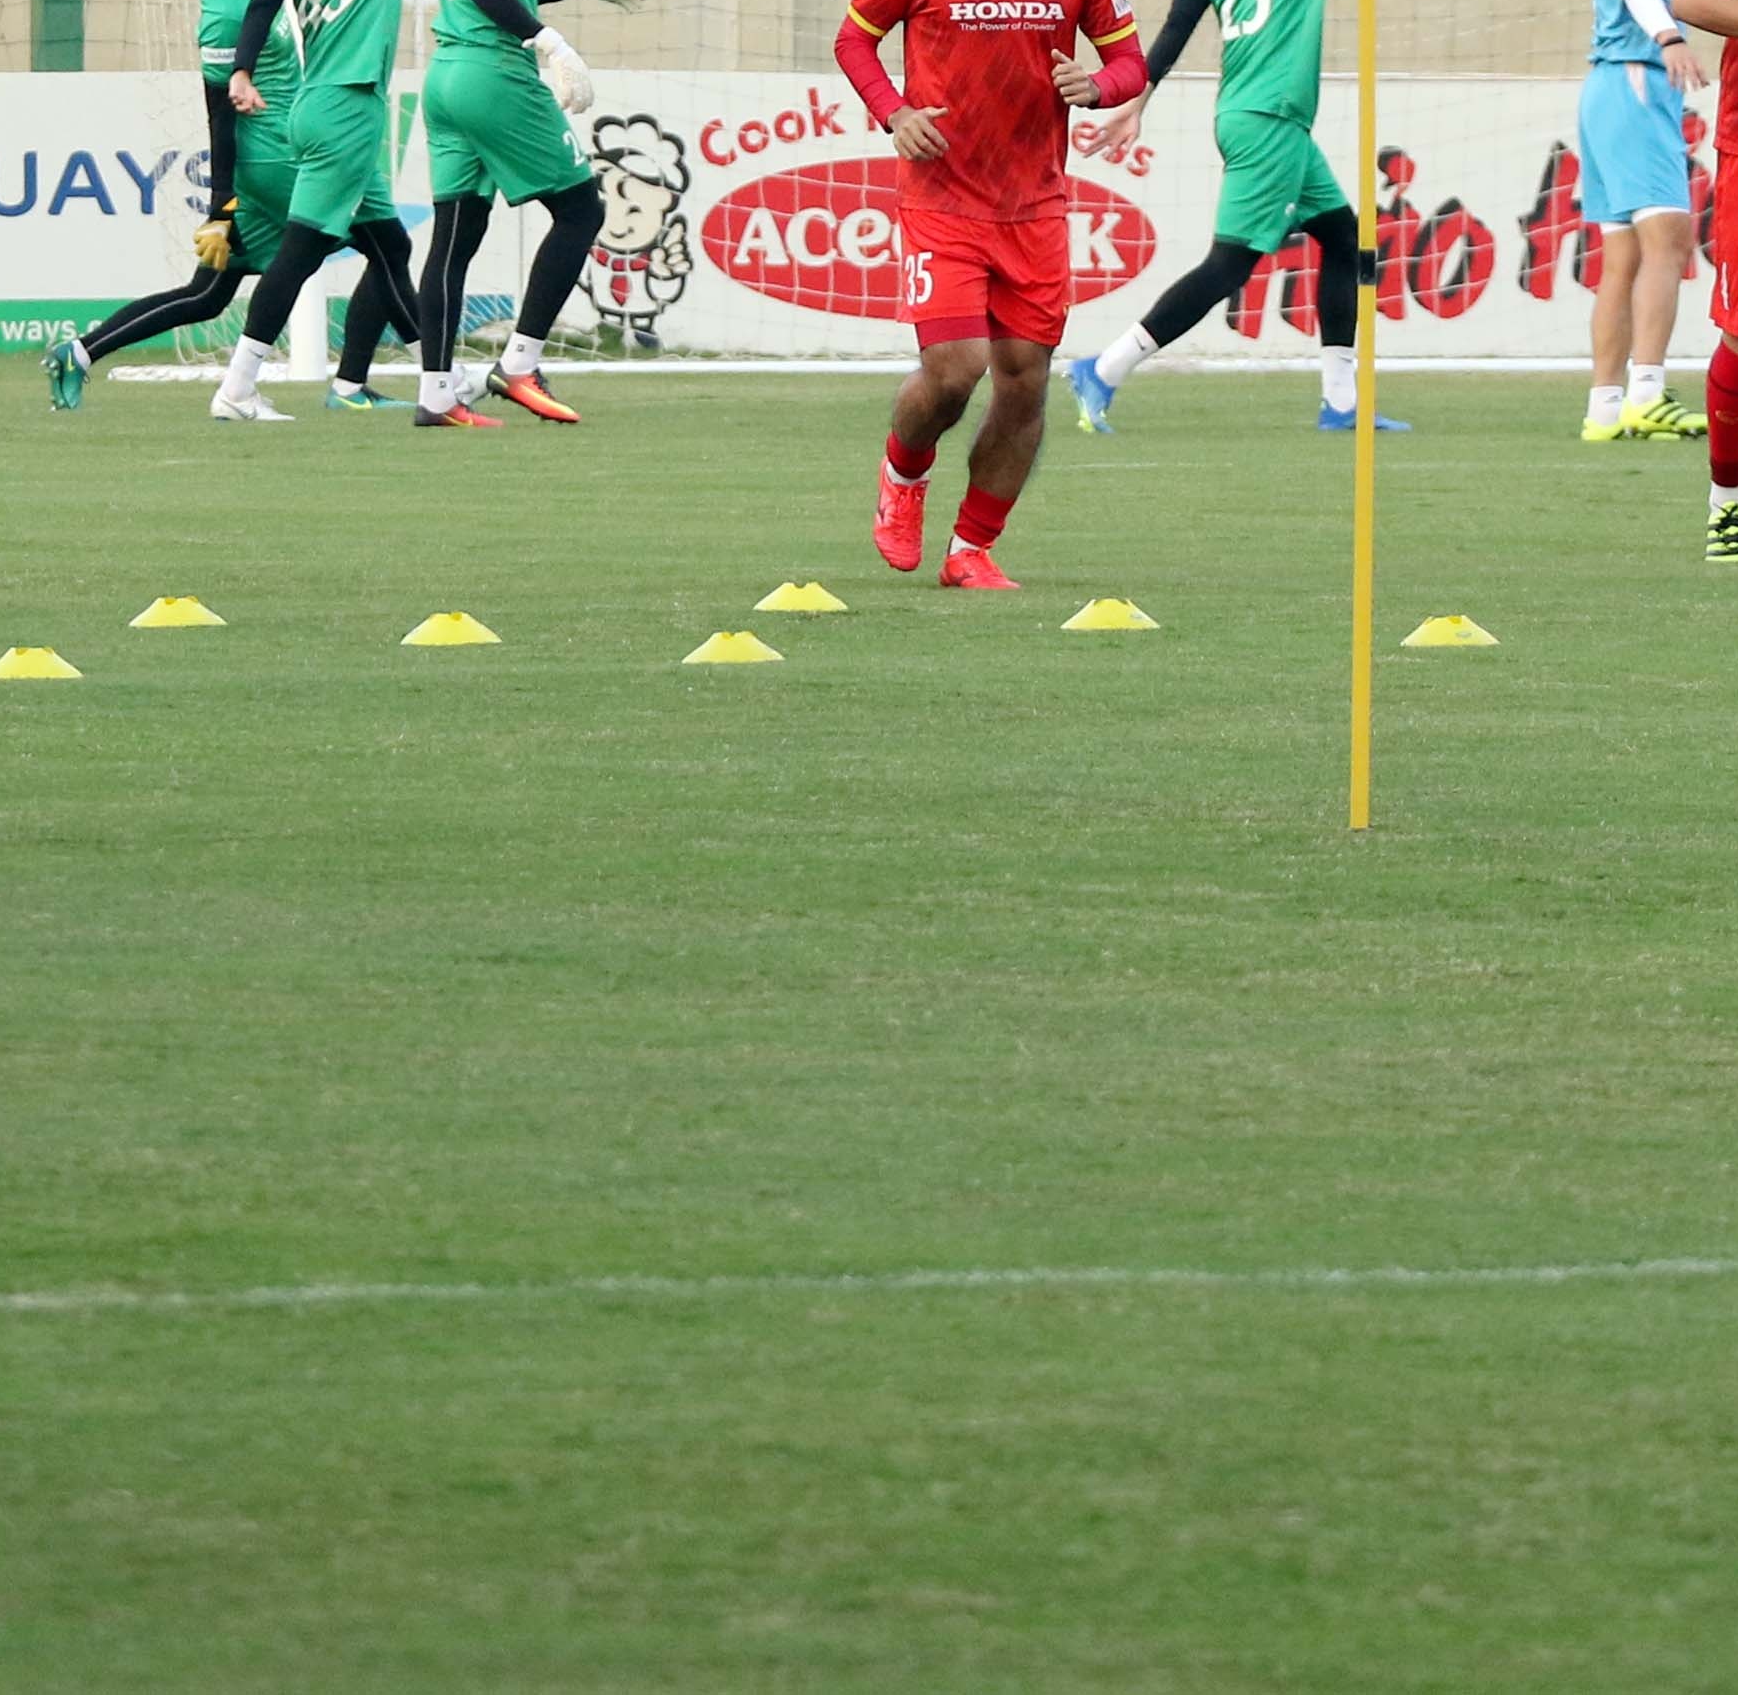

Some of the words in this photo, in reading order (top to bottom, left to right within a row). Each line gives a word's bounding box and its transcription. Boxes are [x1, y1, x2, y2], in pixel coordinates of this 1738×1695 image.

[949, 2, 1066, 20] HONDA
[979, 21, 1010, 32] Power
[699, 87, 844, 167] Cook
[904, 251, 934, 305] 35
